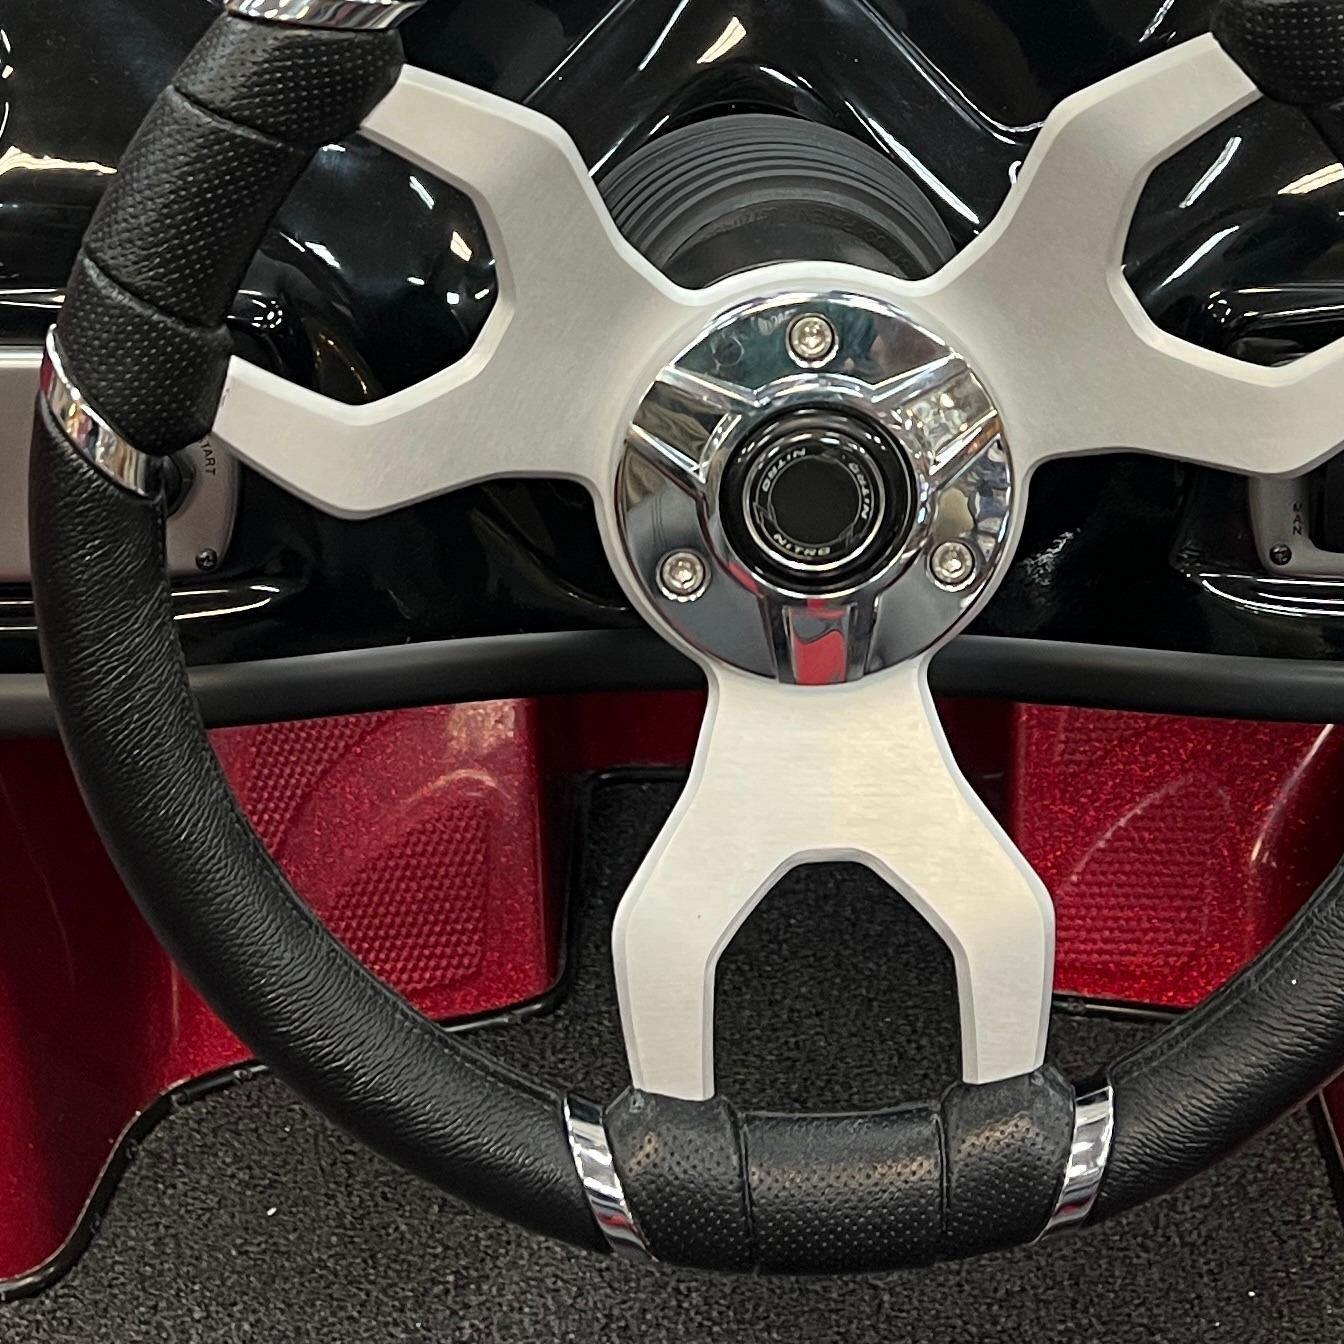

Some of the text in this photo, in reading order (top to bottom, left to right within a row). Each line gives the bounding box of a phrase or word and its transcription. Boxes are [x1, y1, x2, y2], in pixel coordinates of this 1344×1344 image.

[200, 441, 216, 475] TART
[762, 448, 806, 492] NITRO
[848, 462, 871, 519] NITRO
[774, 534, 830, 556] NITRO
